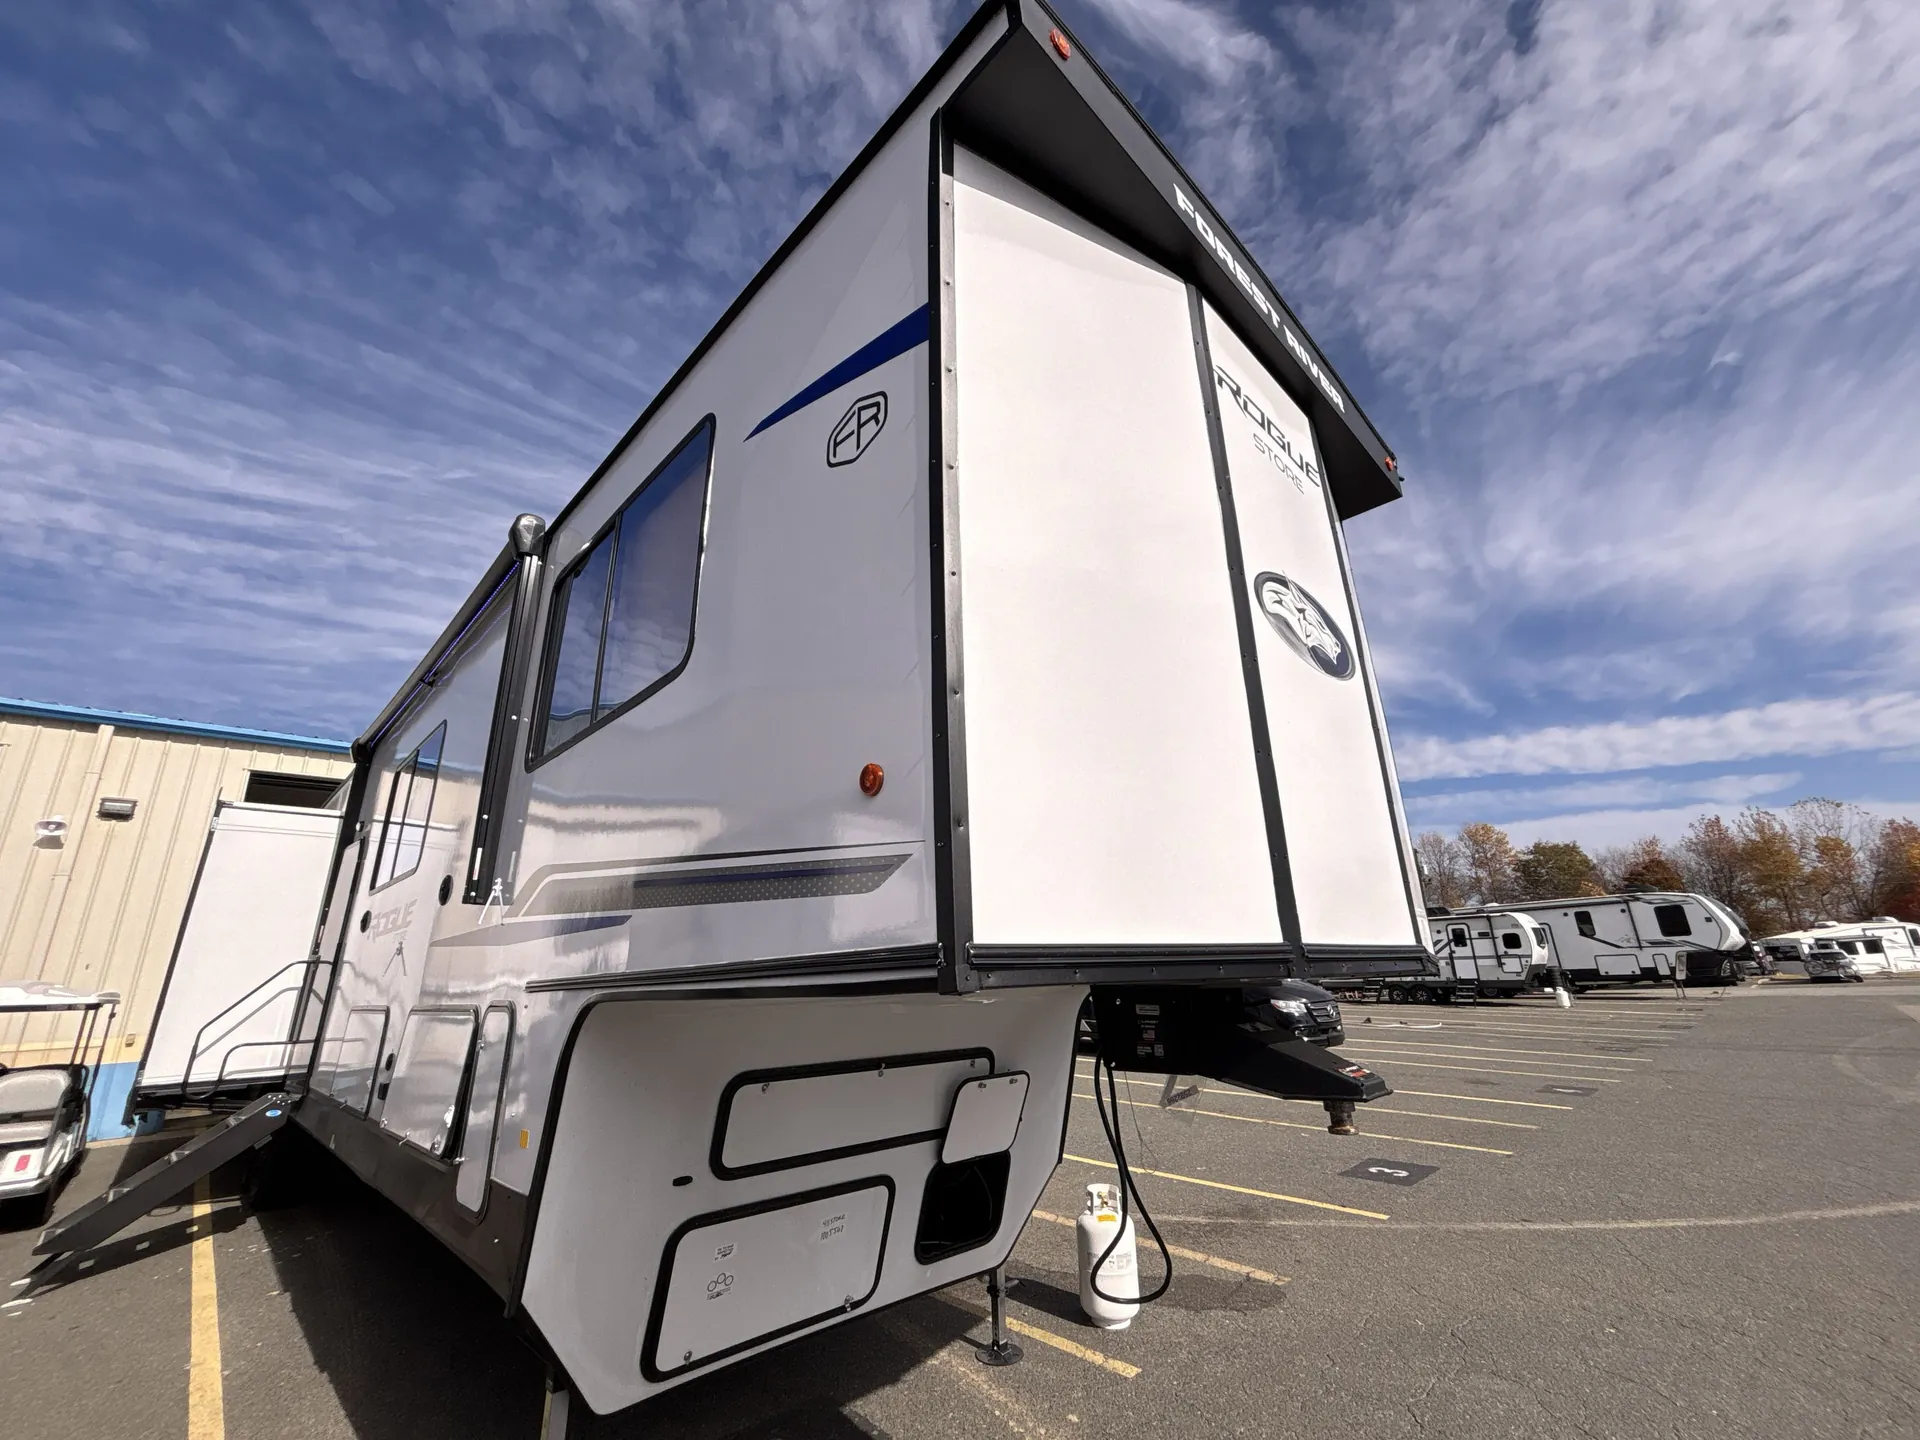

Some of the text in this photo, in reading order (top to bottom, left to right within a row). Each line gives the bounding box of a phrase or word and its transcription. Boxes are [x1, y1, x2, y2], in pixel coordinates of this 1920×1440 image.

[1173, 183, 1346, 414] FOREST RIVER
[1213, 365, 1320, 488] ROGUE
[1253, 432, 1305, 495] STORE
[1367, 1166, 1410, 1177] 3
